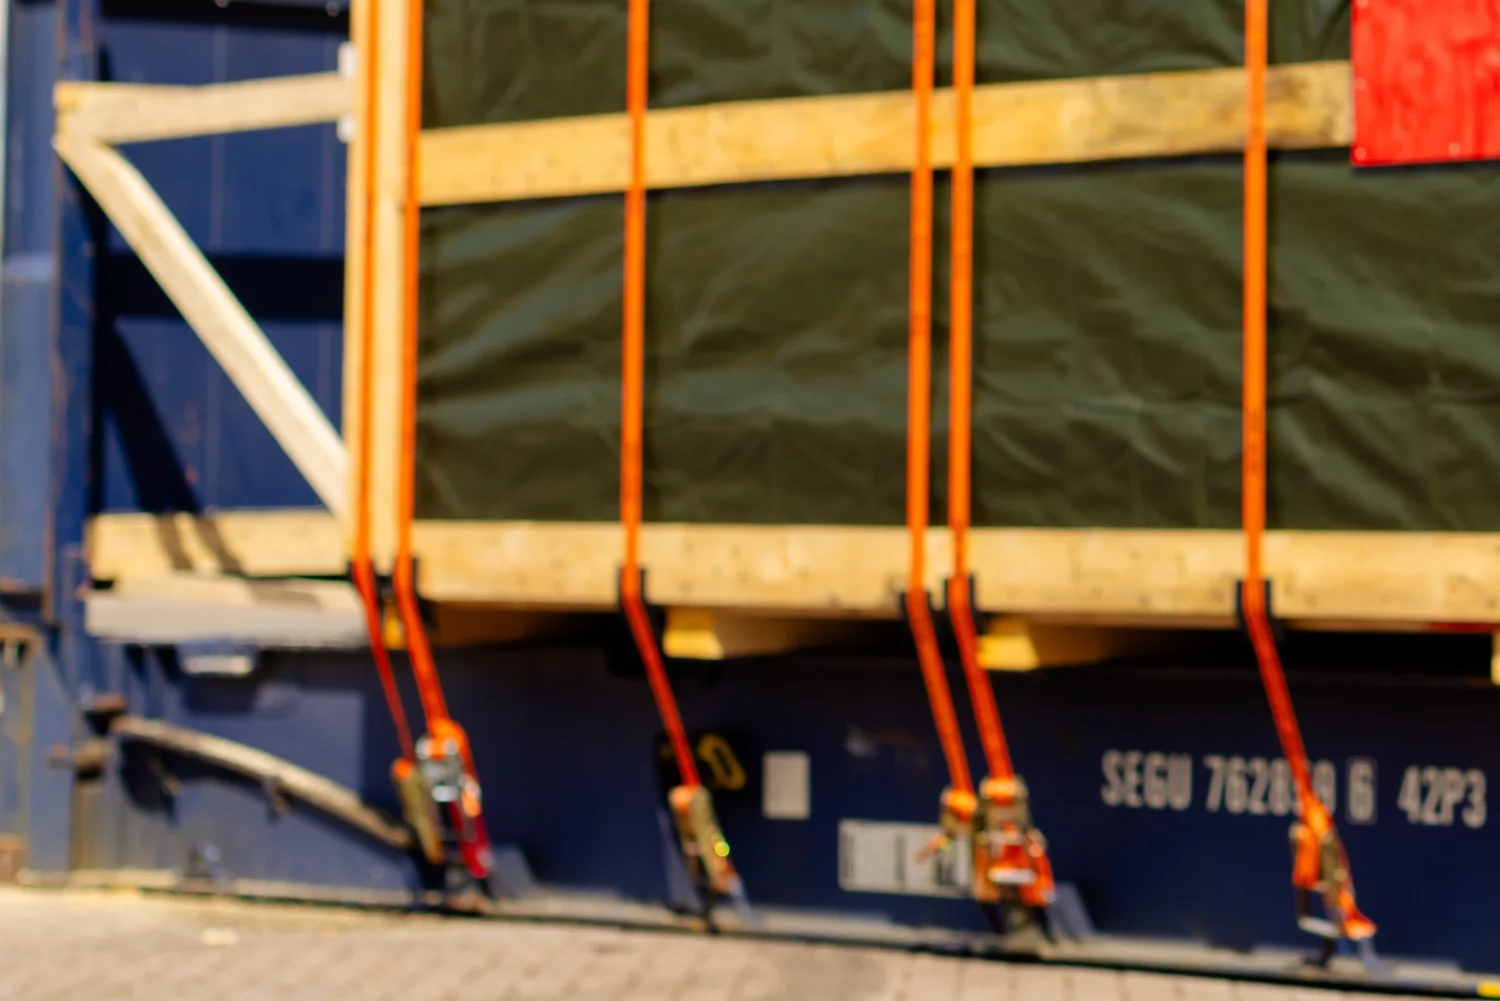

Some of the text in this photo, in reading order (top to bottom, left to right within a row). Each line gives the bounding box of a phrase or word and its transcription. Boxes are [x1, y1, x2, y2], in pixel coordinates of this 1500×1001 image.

[1101, 749, 1192, 810] SEGU
[1203, 755, 1336, 816] 76289
[1348, 759, 1375, 823] 6
[1397, 766, 1487, 827] 42P3
